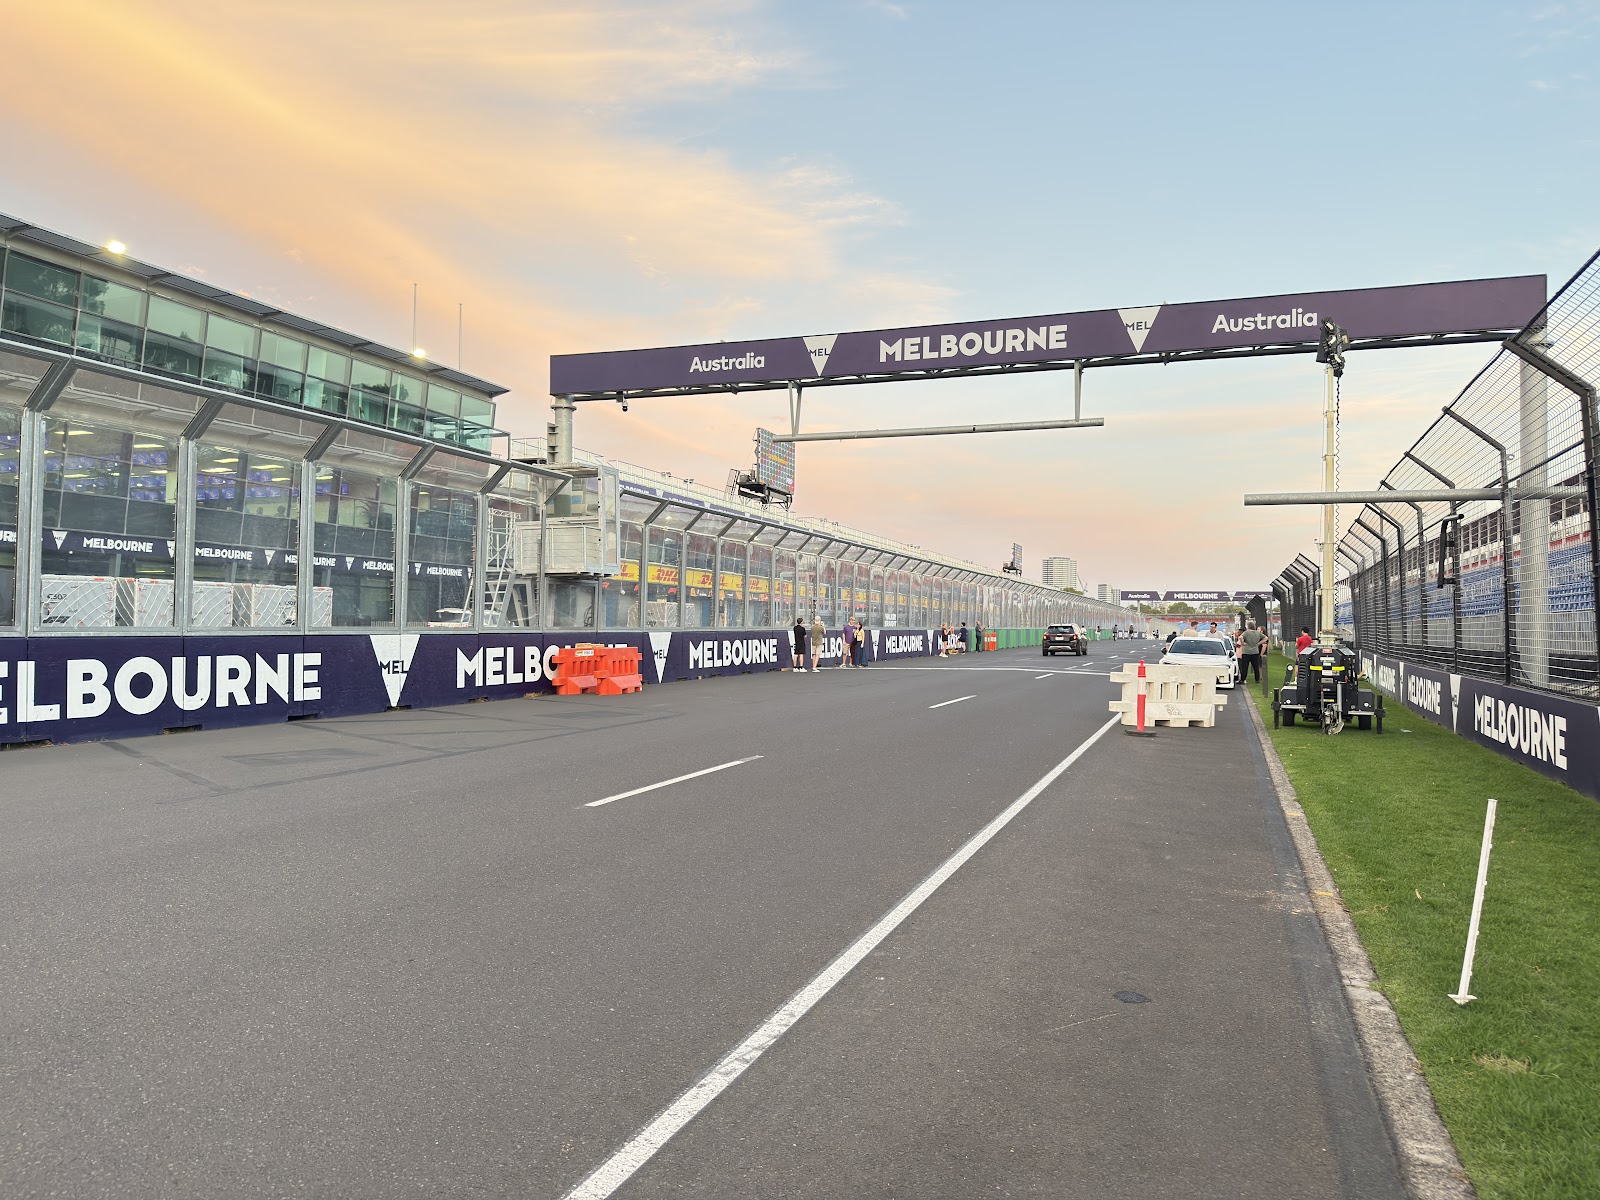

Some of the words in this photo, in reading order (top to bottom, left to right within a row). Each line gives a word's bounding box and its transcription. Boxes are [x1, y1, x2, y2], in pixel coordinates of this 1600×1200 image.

[689, 352, 765, 373] Australia
[809, 348, 830, 358] MEL
[879, 324, 1068, 363] MELBOURNE
[1125, 320, 1151, 332] MEL
[1211, 307, 1318, 334] Australia
[83, 536, 153, 553] MELBOURNE
[195, 547, 253, 561] MELBOURNE
[426, 566, 462, 577] MELBOURNE
[380, 659, 408, 675] MEL
[689, 638, 778, 670] MELBOURNE
[885, 635, 923, 654] MELBOURNE
[1407, 674, 1441, 716] MELBOURNE
[1474, 692, 1568, 771] MELBOURNE
